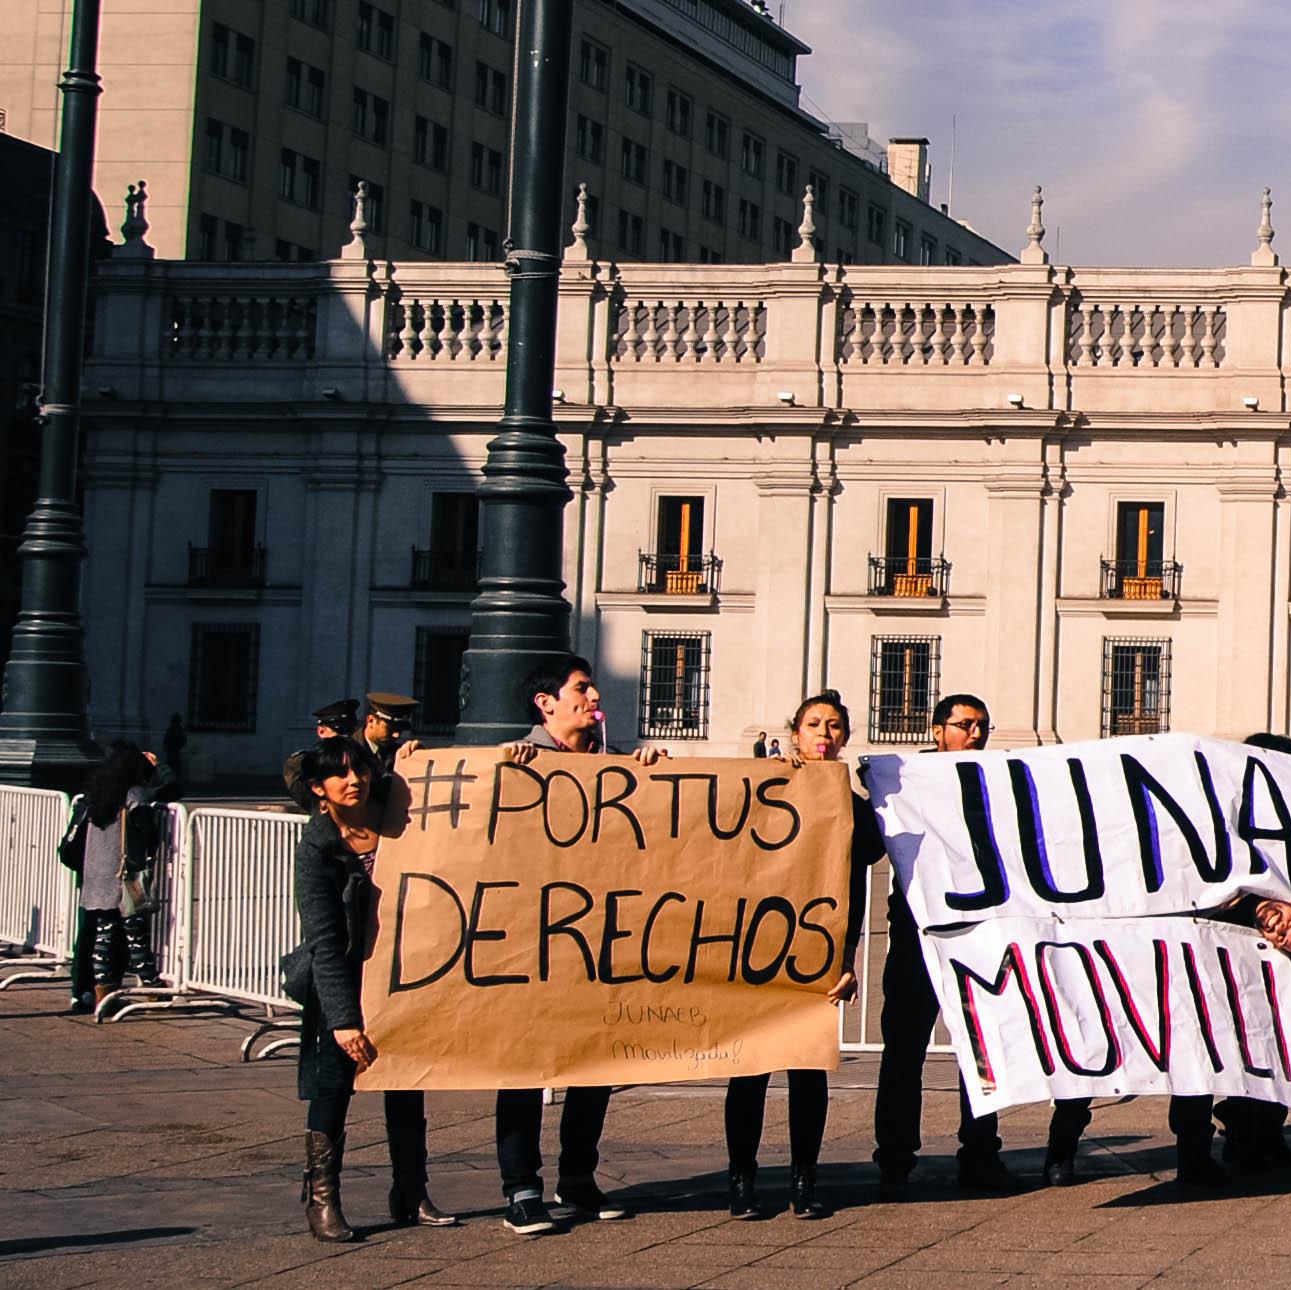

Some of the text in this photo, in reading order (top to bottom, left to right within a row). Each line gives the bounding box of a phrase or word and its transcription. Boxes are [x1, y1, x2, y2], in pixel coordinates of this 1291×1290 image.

[409, 758, 803, 852] #PORTUS
[389, 872, 838, 997] DERECHOS
[603, 1001, 707, 1026] JUNAEB
